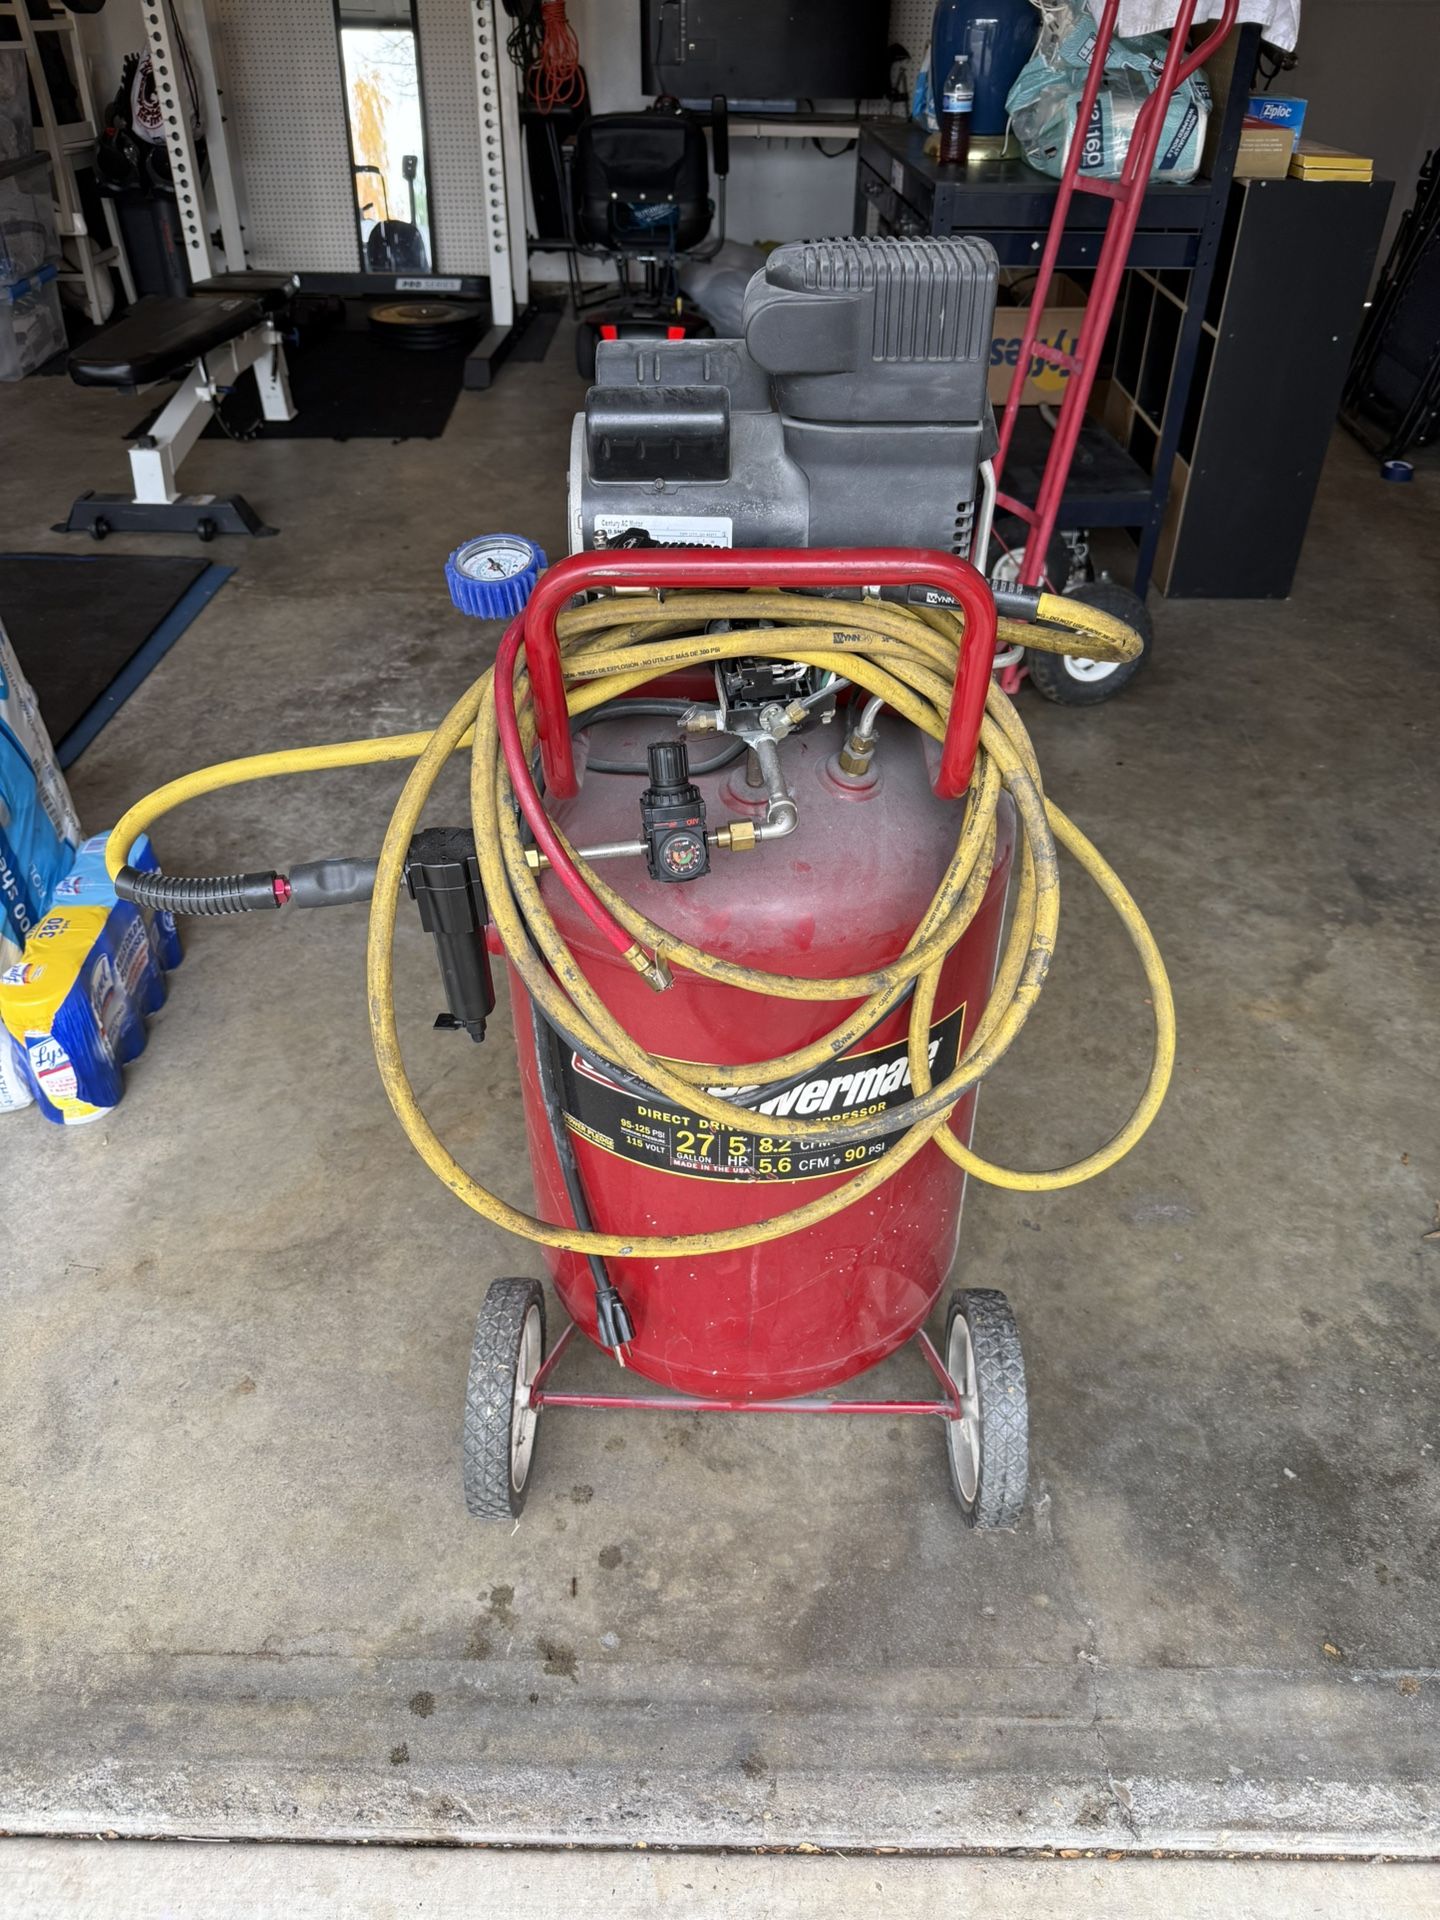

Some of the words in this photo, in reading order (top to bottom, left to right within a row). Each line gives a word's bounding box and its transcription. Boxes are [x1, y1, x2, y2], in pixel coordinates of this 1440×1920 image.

[1263, 104, 1293, 119] Ziploc
[637, 1106, 690, 1126] DIRECT
[620, 1118, 651, 1134] 95-125
[652, 1129, 666, 1138] PSI
[676, 1130, 715, 1156] 27
[728, 1135, 746, 1156] 5
[759, 1137, 792, 1153] 8.2
[626, 1136, 643, 1148] 115
[645, 1143, 666, 1154] VOLT
[673, 1159, 698, 1169] MADE
[676, 1152, 712, 1163] GALLON
[759, 1158, 792, 1174] 5.6
[798, 1158, 830, 1171] CFM
[844, 1145, 866, 1163] 90
[868, 1142, 885, 1155] PSI
